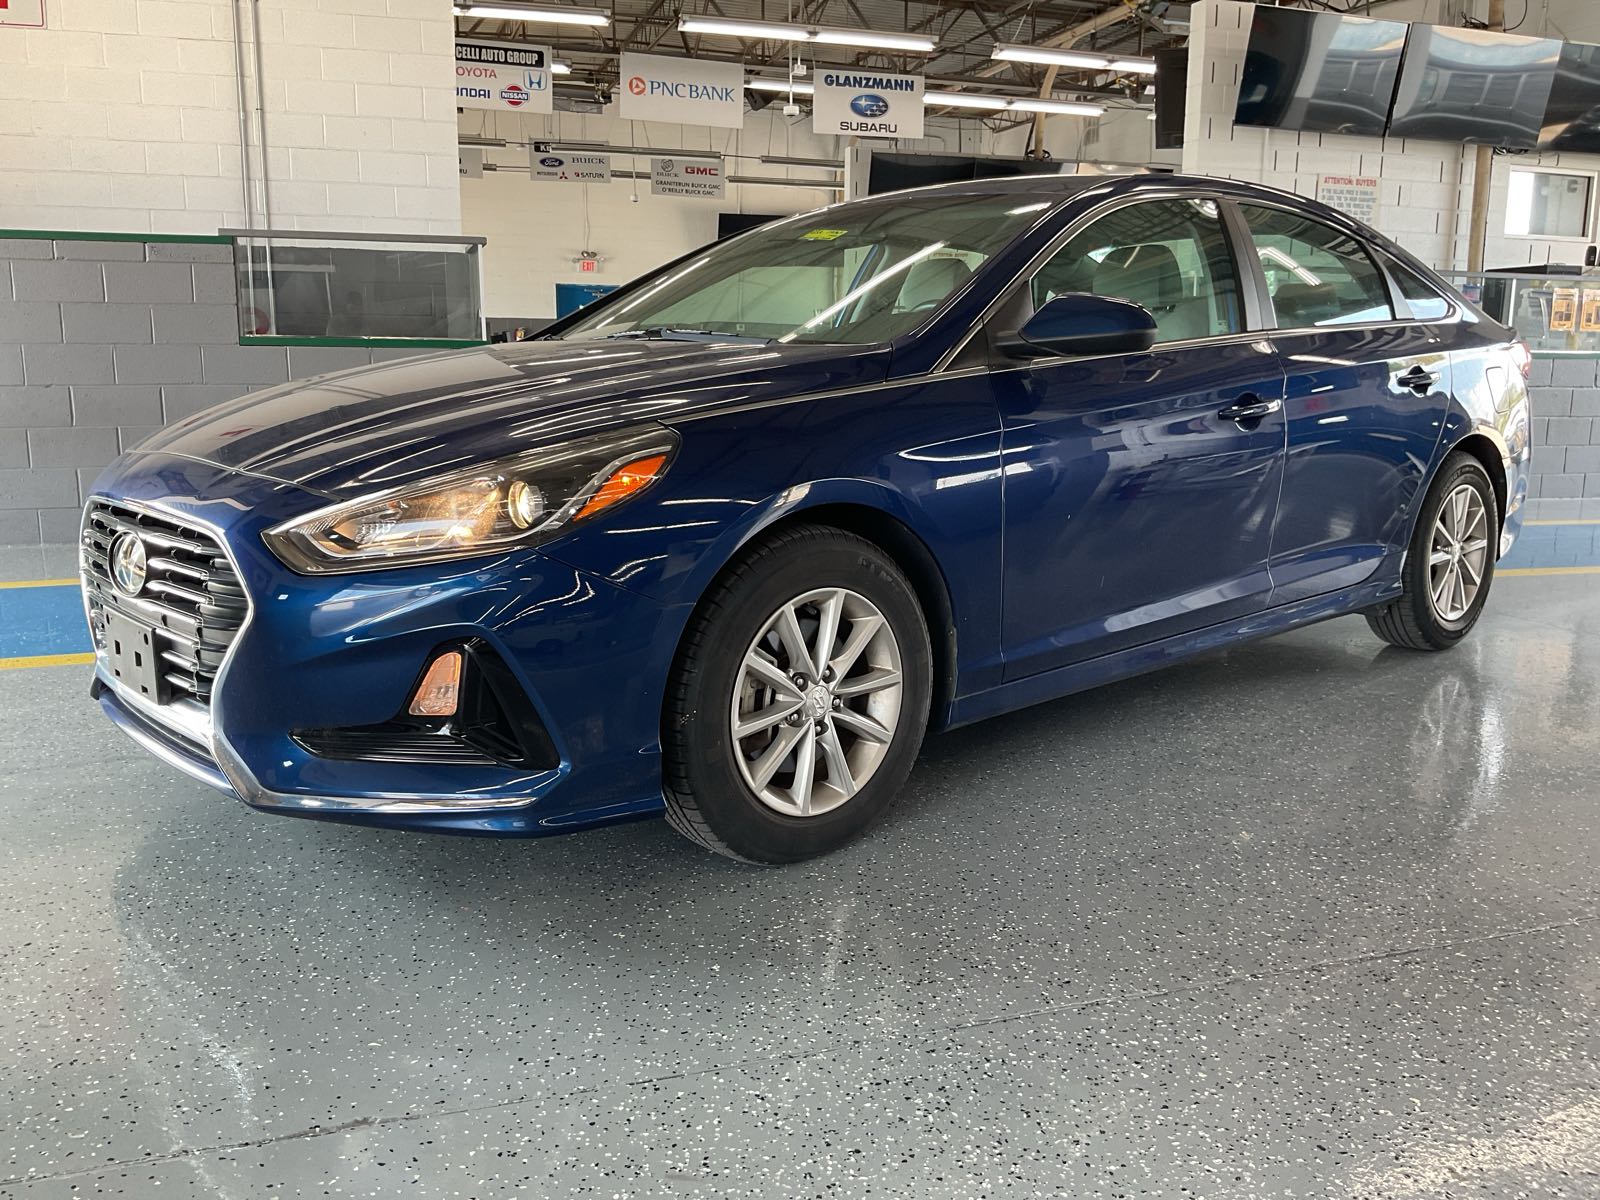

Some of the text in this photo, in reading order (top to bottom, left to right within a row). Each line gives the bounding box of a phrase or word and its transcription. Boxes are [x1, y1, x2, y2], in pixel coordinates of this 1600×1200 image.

[481, 48, 506, 62] AUTO
[507, 51, 539, 65] GROUP
[824, 74, 915, 91] GLANZMANN
[501, 91, 529, 100] NISSAN
[649, 80, 735, 102] PNC BANK
[839, 121, 898, 133] SUBARU
[544, 158, 560, 166] Ford
[571, 157, 605, 165] BUICK
[685, 166, 719, 176] GMC
[1355, 178, 1377, 187] BUYERS
[582, 261, 595, 272] EXIT
